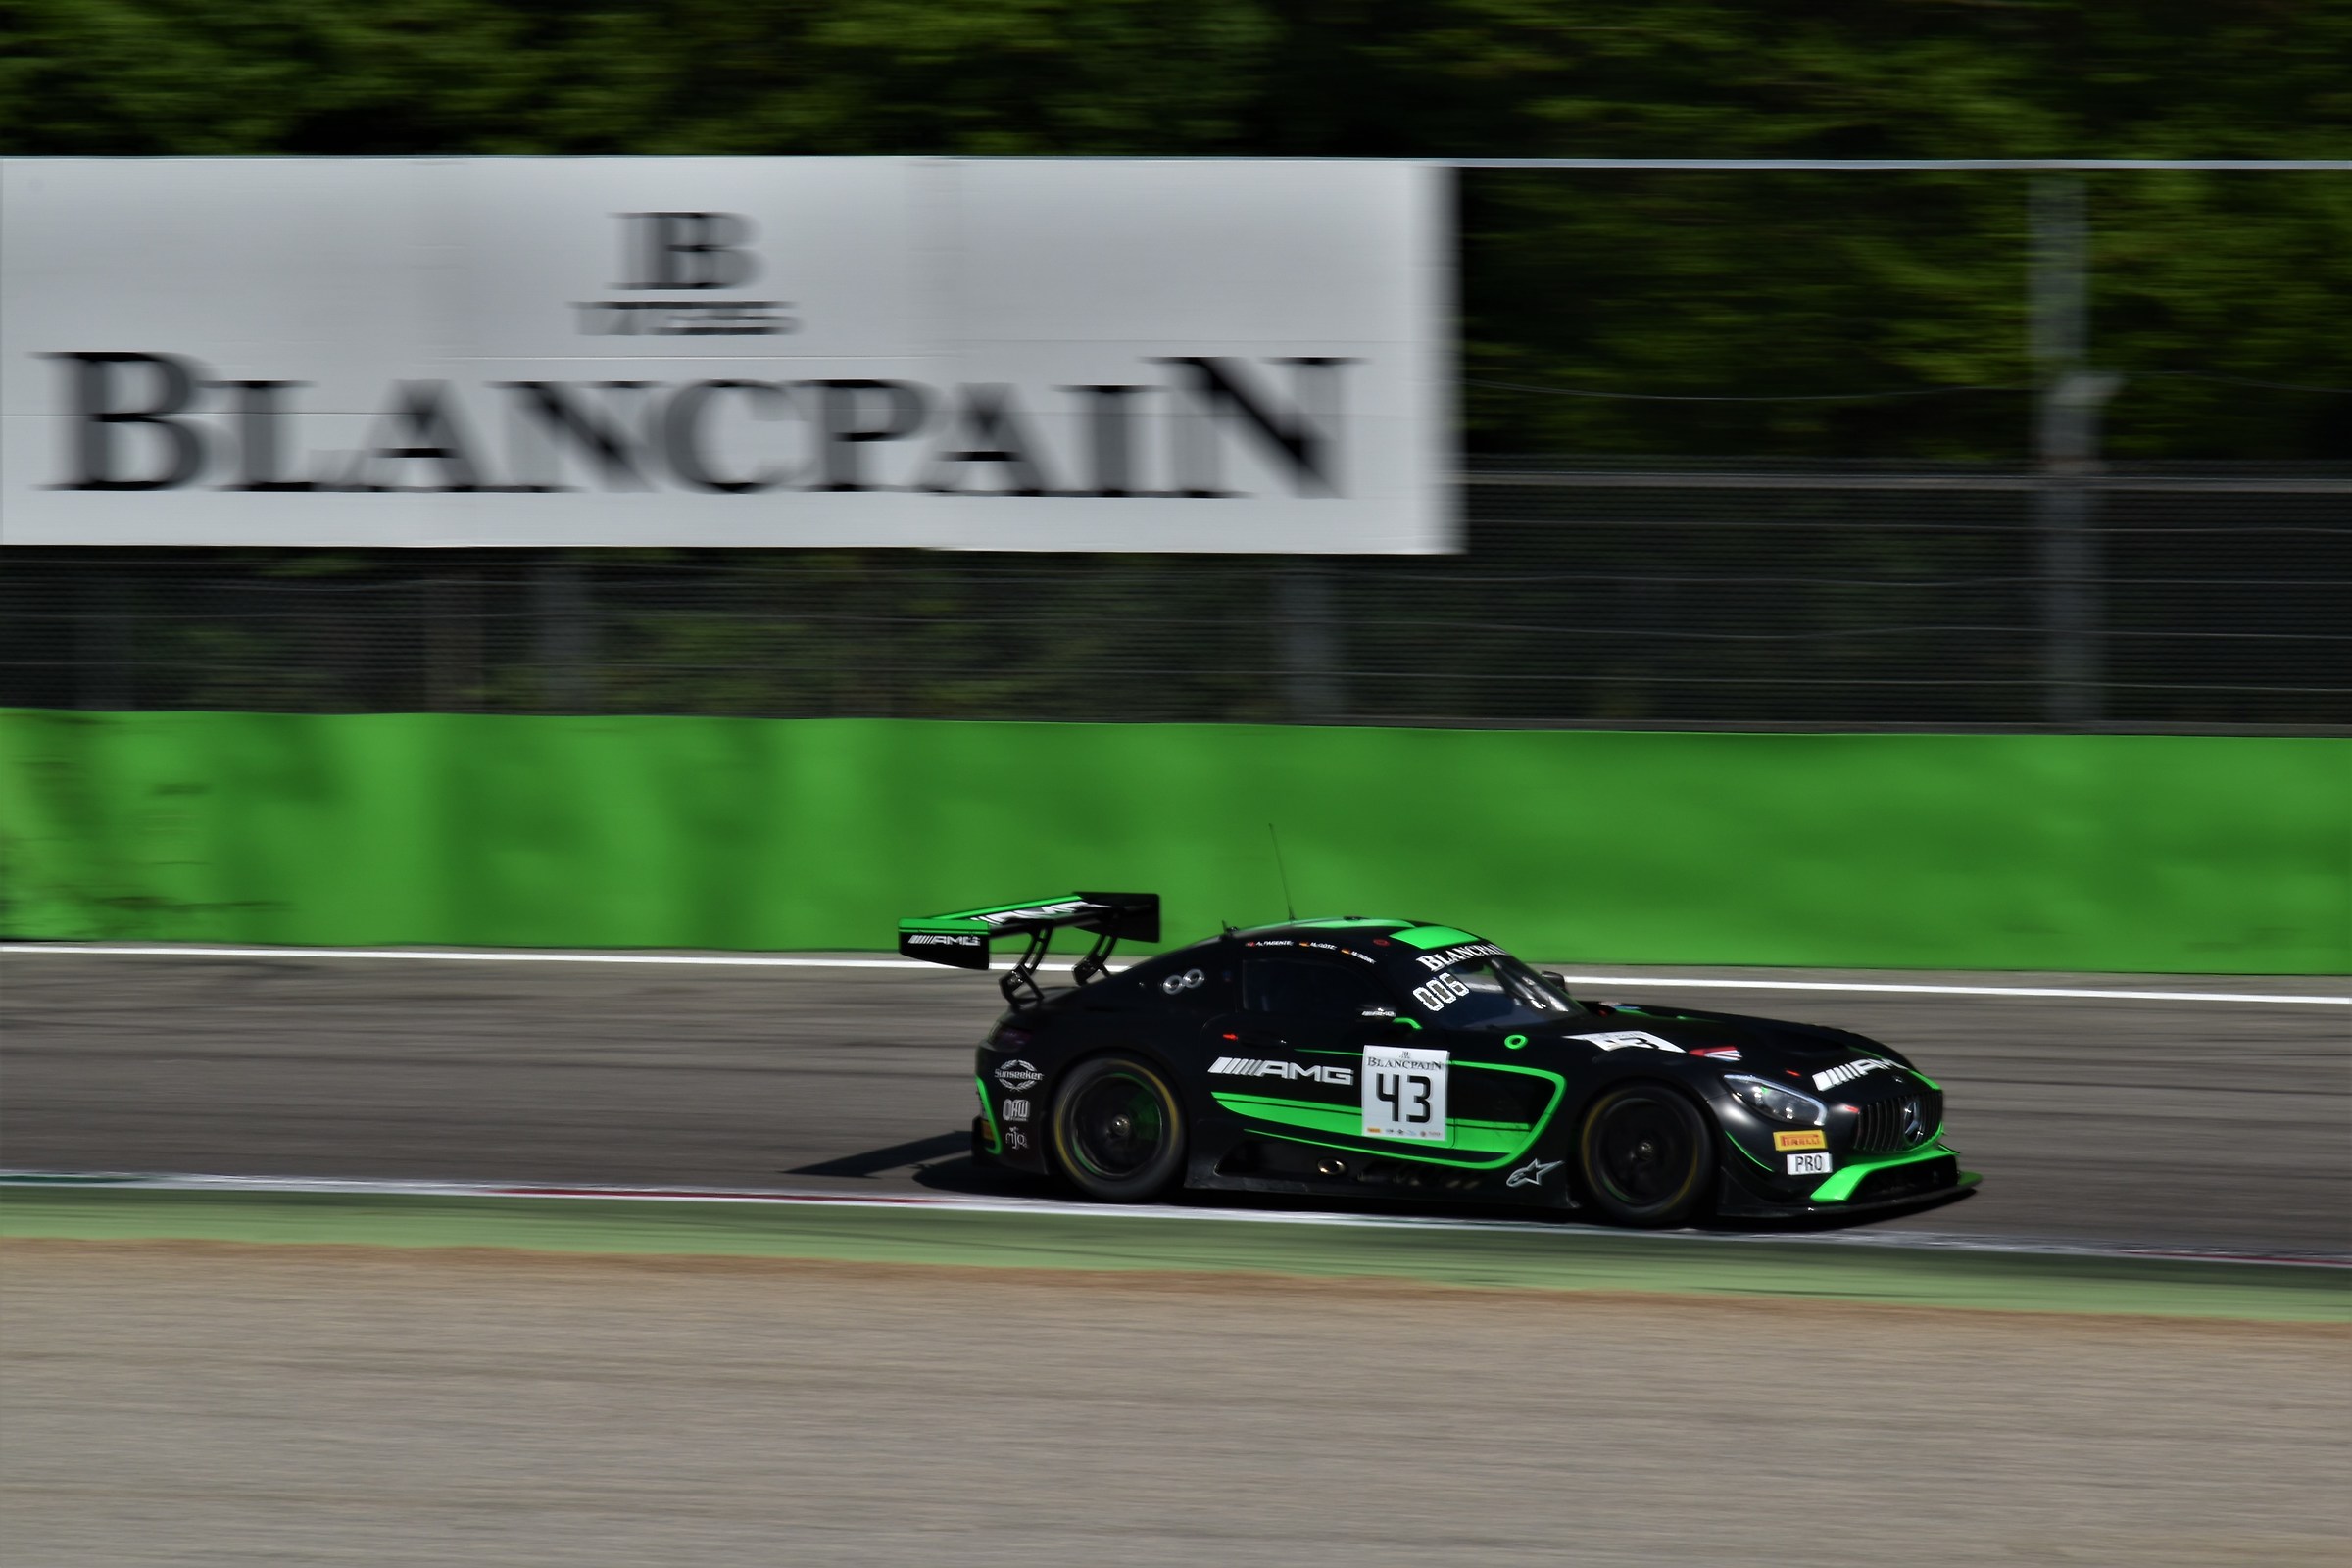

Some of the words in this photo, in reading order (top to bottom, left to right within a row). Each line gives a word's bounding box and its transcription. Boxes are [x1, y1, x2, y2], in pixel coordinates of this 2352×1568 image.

[33, 351, 1364, 498] BLANCPAIN
[995, 1068, 1045, 1080] Sunseeker
[1254, 1060, 1354, 1086] AMG
[1367, 1057, 1443, 1071] BLANCPAIN
[1376, 1073, 1431, 1124] 43
[1795, 1154, 1823, 1172] PRO
